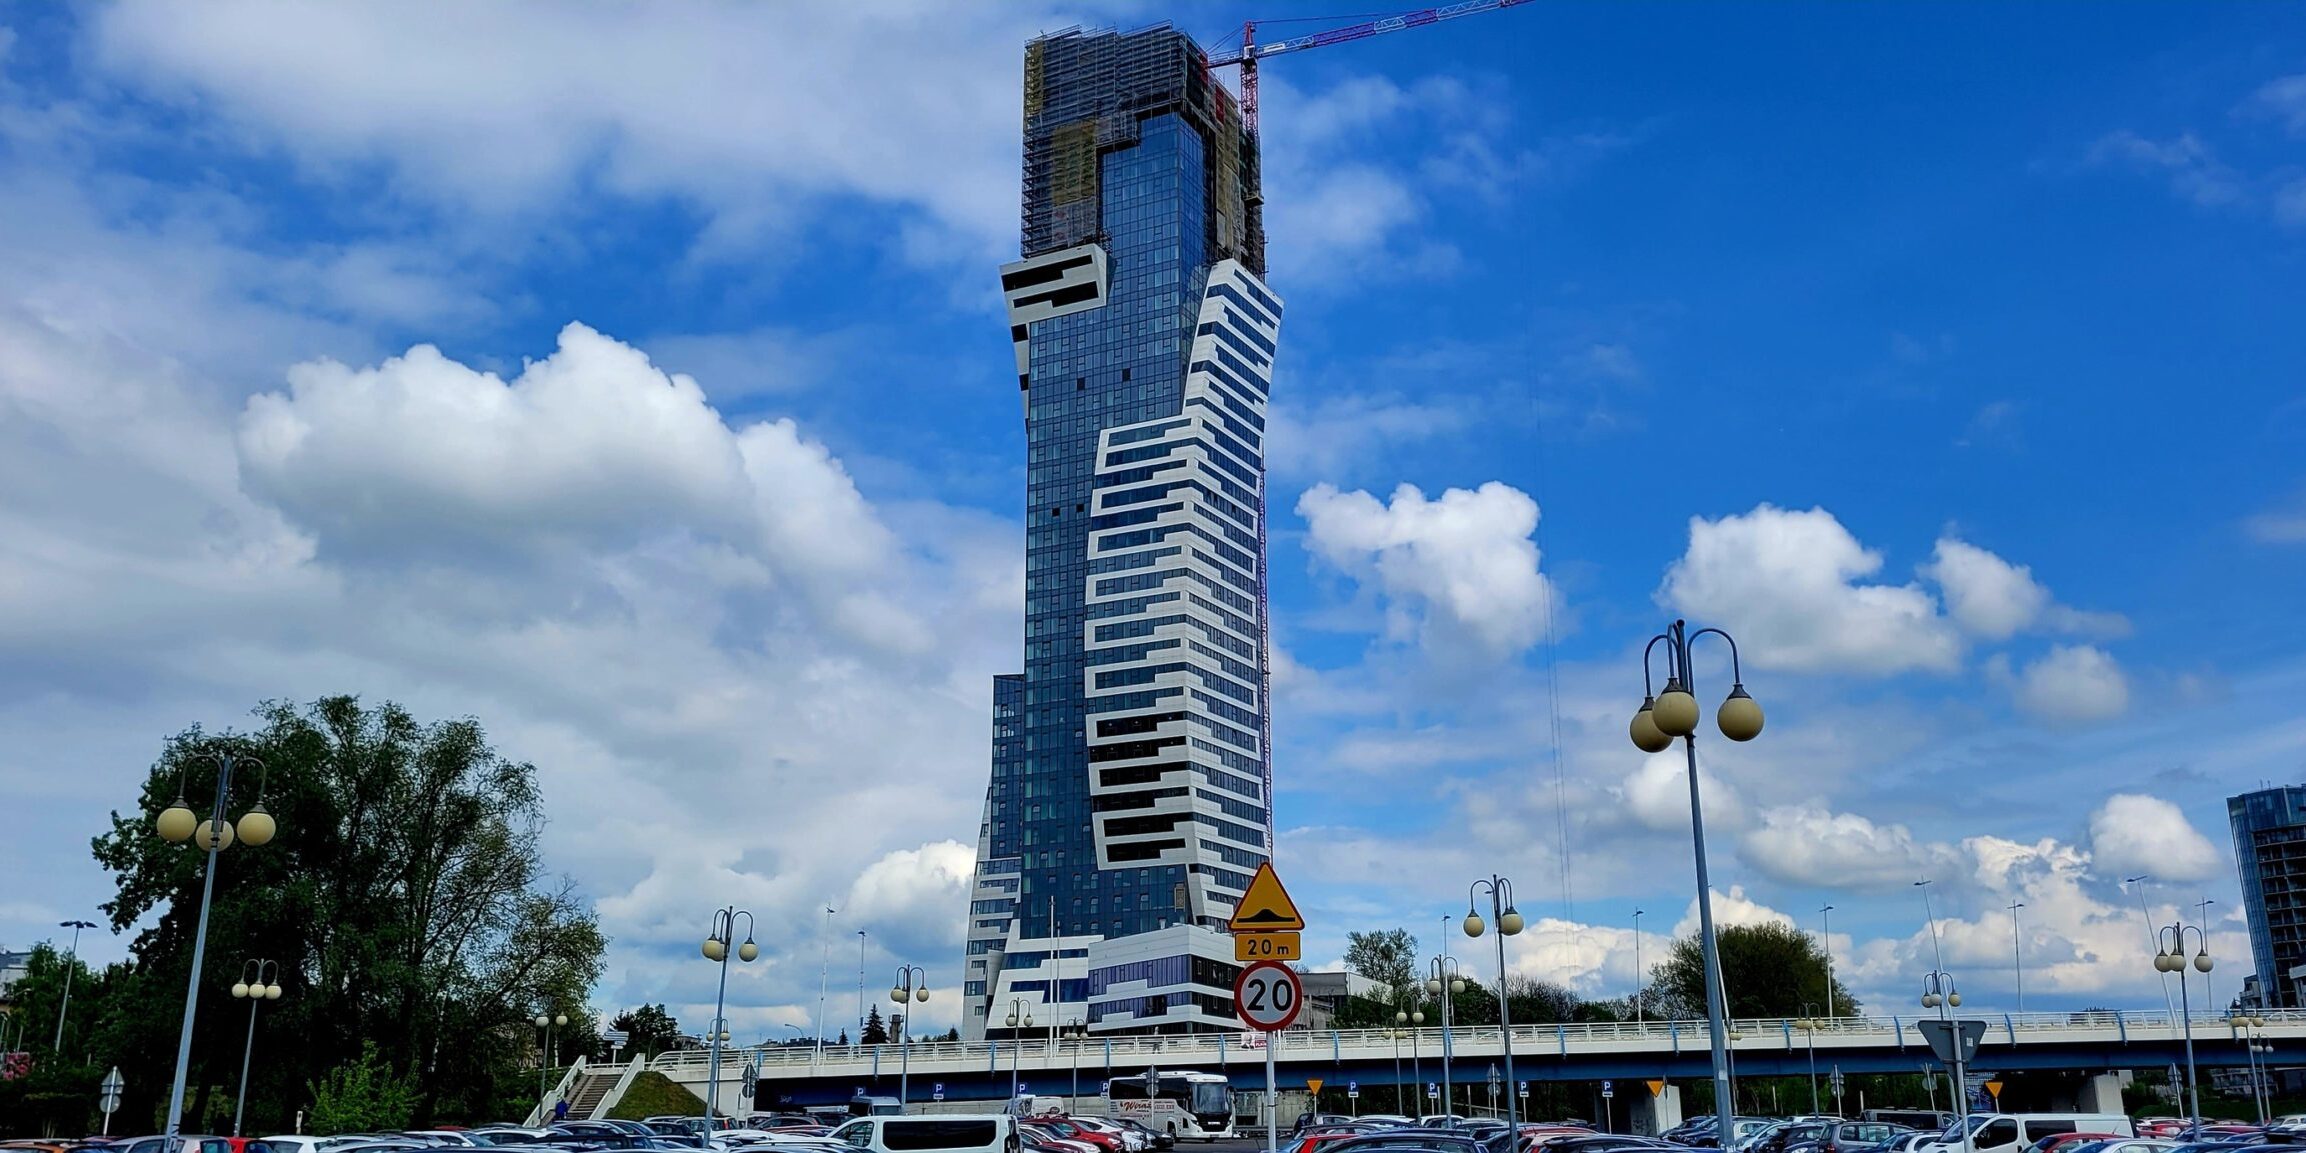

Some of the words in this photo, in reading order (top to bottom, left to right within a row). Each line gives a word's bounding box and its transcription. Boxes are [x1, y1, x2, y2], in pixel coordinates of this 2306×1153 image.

[1247, 939, 1271, 955] 20
[1277, 945, 1289, 955] m
[1247, 978, 1293, 1012] 20
